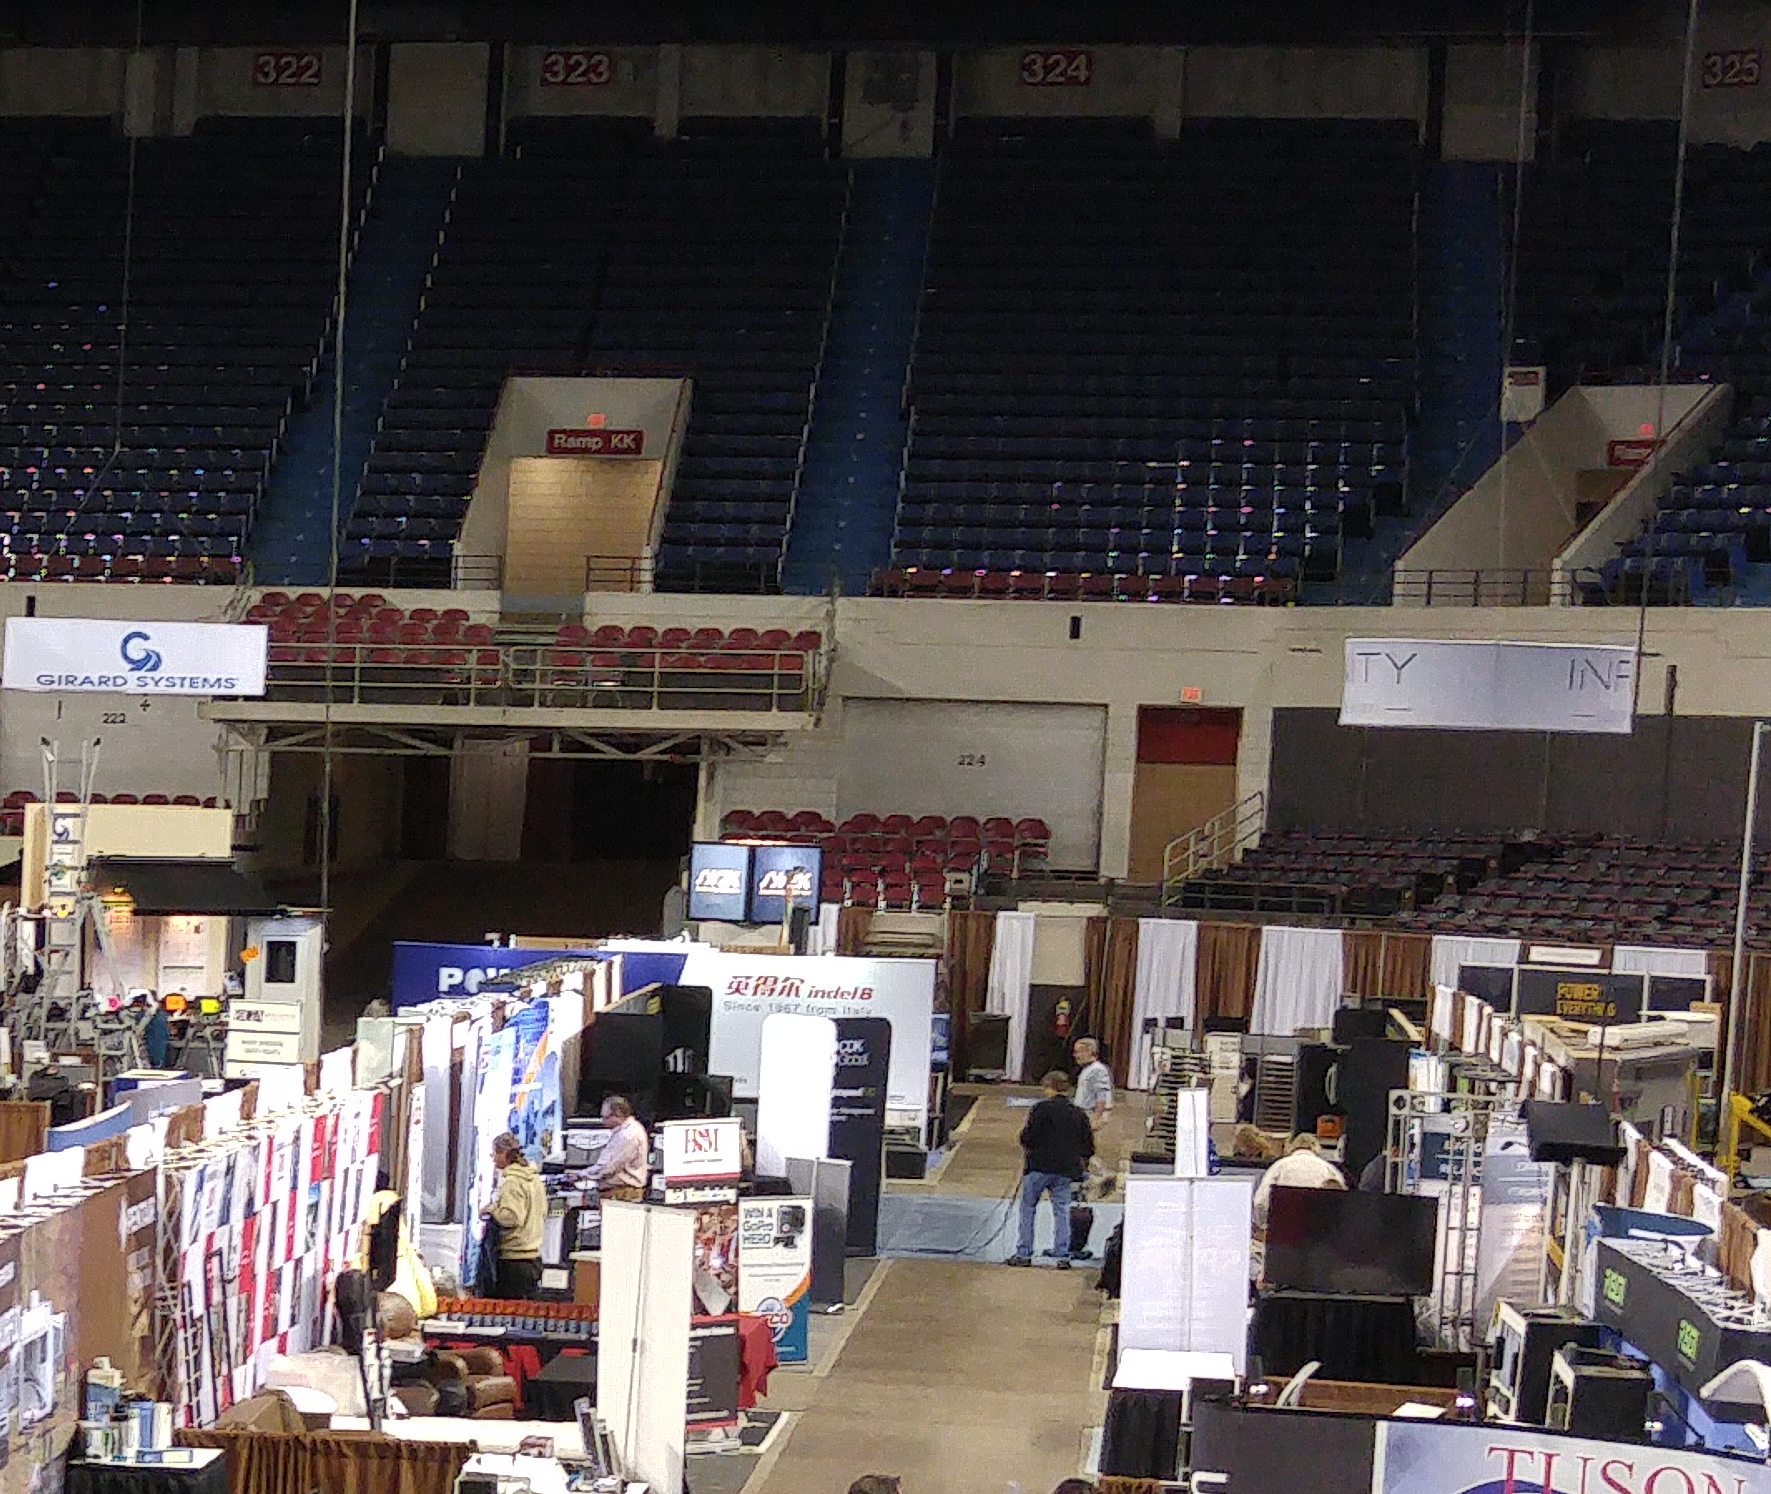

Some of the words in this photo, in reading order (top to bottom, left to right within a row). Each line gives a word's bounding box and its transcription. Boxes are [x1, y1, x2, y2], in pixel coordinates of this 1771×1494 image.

[259, 55, 319, 84] 322
[545, 54, 609, 84] 323
[1023, 52, 1089, 83] 324
[1704, 51, 1759, 84] 325
[554, 434, 602, 451] Ramp
[36, 674, 128, 687] GIRARD
[135, 676, 237, 690] SYSTEMS
[102, 712, 126, 724] 222
